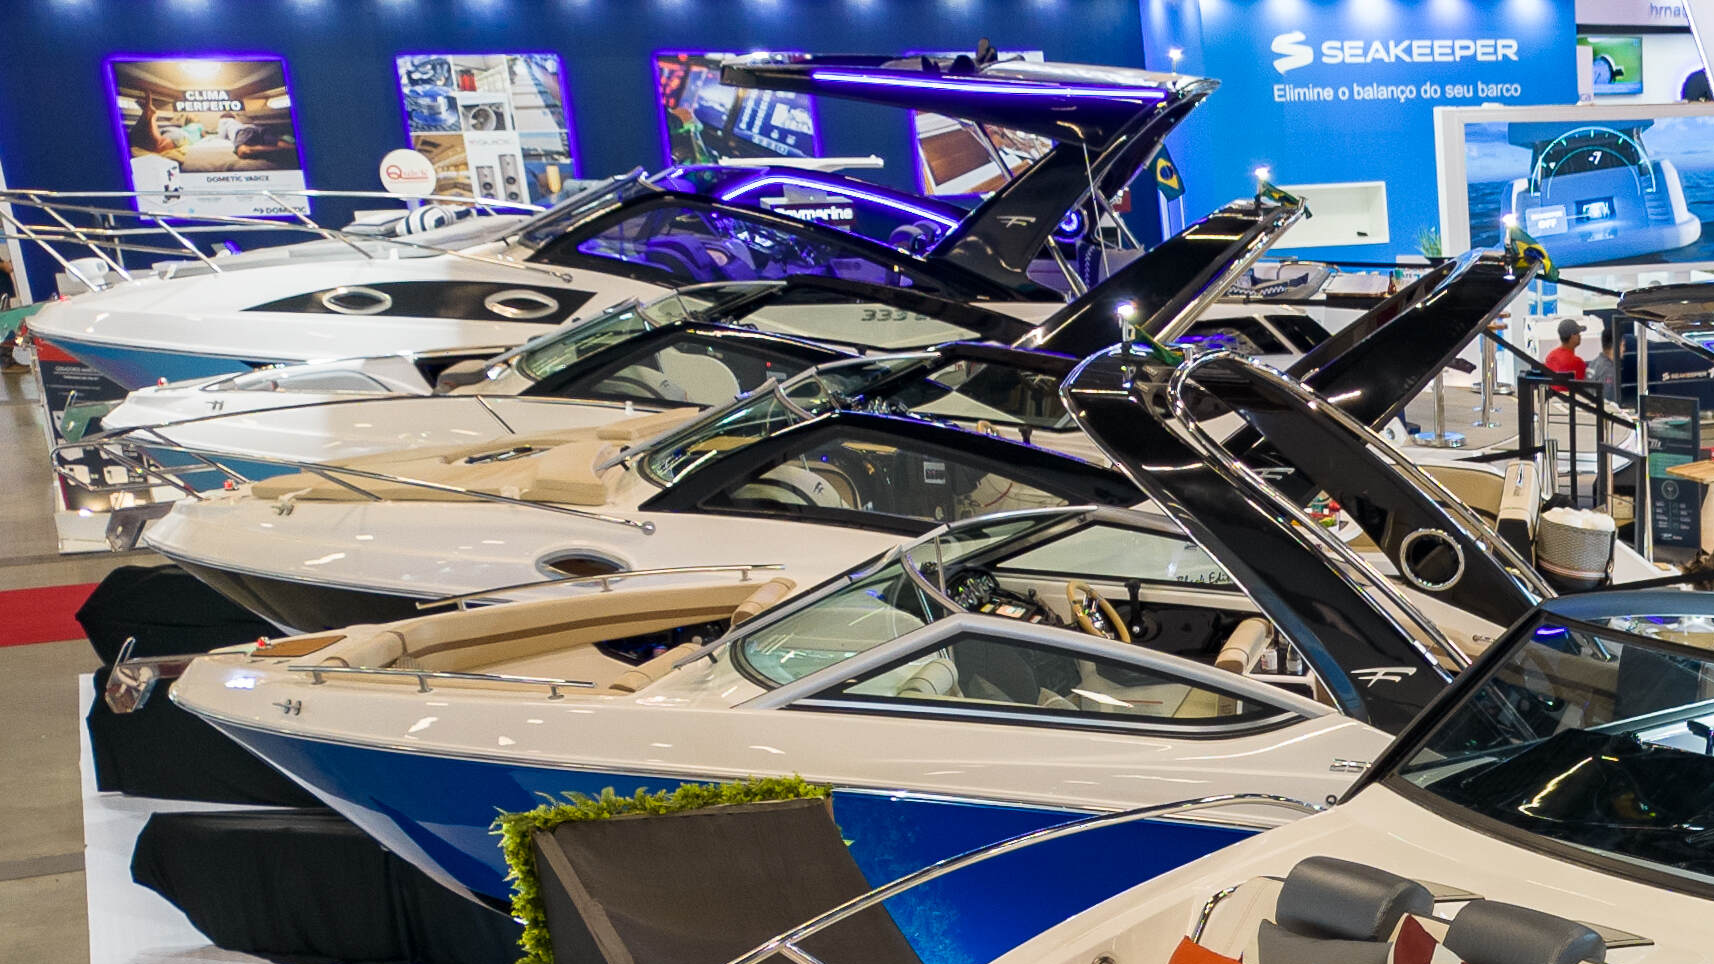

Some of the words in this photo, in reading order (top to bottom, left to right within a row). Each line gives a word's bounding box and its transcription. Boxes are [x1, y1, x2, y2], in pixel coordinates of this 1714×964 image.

[1321, 38, 1519, 64] SEAKEEPER
[185, 90, 229, 101] CLIMA
[1273, 83, 1333, 102] Elimine
[1338, 86, 1349, 100] o
[1353, 82, 1416, 103] balanço
[1421, 81, 1441, 99] do
[1448, 84, 1473, 98] seu
[1477, 81, 1521, 97] barco
[175, 100, 243, 112] PERFEITO
